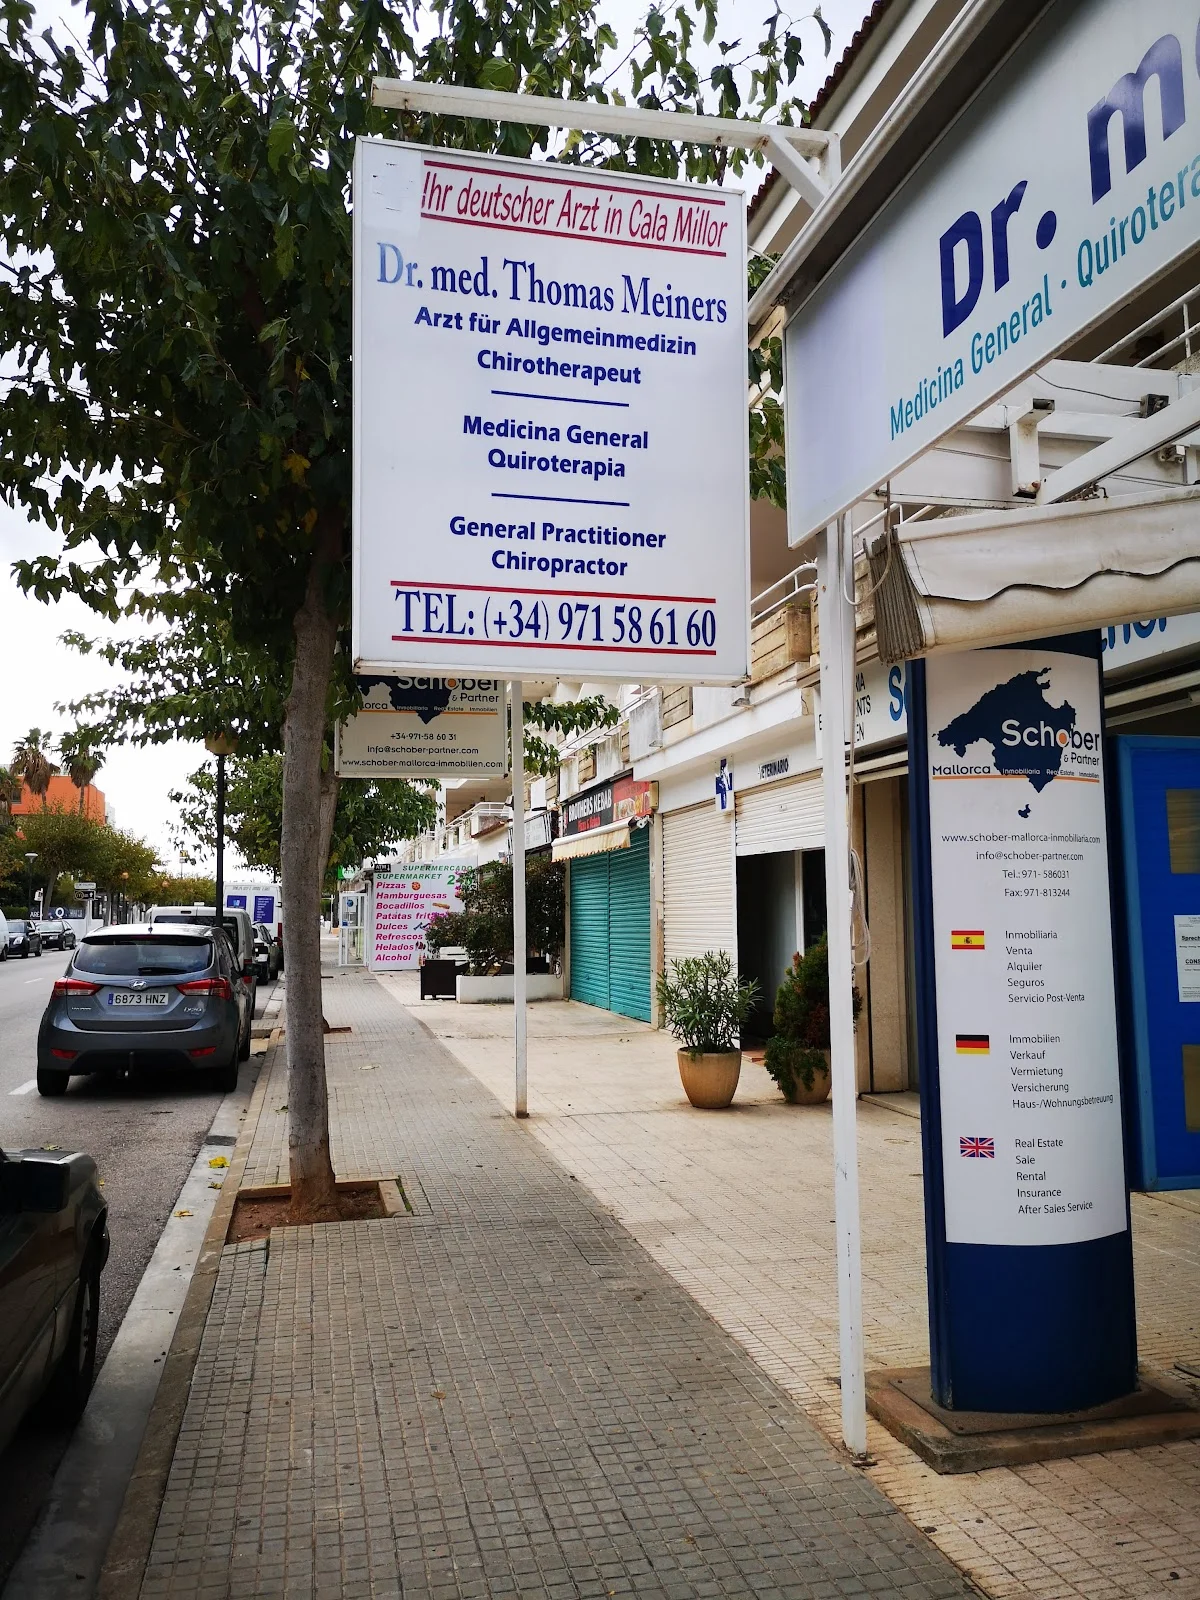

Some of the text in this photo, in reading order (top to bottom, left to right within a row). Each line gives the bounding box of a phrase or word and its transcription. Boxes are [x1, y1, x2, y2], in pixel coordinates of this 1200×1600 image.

[939, 17, 1200, 339] Dr. m
[421, 171, 729, 248] Ihr deutscher Arzt in Cala Millor
[376, 242, 727, 323] Dr. med. Thomas Meiners
[414, 306, 697, 355] Arzt für Allgemeinmedizin
[889, 358, 964, 441] Medicina
[970, 275, 1053, 375] General
[477, 349, 642, 386] Chirotherapeut
[463, 415, 649, 450] Medicina General
[488, 448, 626, 481] Quiroterapia
[449, 516, 667, 549] General Practitioner
[491, 549, 628, 578] Chiropractor
[395, 588, 716, 647] TEL: (+34) 971 58 61 60
[459, 692, 499, 703] Partner
[436, 733, 447, 741] 60
[1001, 718, 1100, 752] Schober
[342, 759, 503, 769] www.schober-mallorca-immobilien.com
[1070, 752, 1100, 767] Partner
[932, 763, 991, 776] Mallorca
[594, 788, 612, 814] KEBAB
[941, 832, 1101, 844] www.schober-mallorca-inmobiliaria.com
[976, 850, 1084, 862] info@schober-partner.com
[376, 873, 443, 881] SUPERMARKET
[1043, 869, 1070, 879] 586031
[376, 881, 407, 890] Pizzas
[376, 891, 448, 901] Hamburguesas
[375, 902, 425, 910] Bocadillos
[375, 912, 412, 920] Patatas
[375, 922, 408, 931] Dulces
[375, 933, 423, 941] Refrescos
[1005, 930, 1058, 940] Inmobiliaria
[375, 943, 414, 951] Helados
[1006, 946, 1033, 956] Venta
[375, 953, 411, 962] Alcohol
[1007, 962, 1043, 973] Alquiler
[1007, 977, 1045, 989] Seguros
[115, 994, 166, 1004] 6873 HNZ
[1008, 993, 1085, 1003] Servicio Post-Venta
[1009, 1034, 1061, 1044] Immobilien
[1010, 1050, 1046, 1060] Verkauf
[1011, 1066, 1064, 1078] Vermietung
[1011, 1082, 1069, 1094] Versicherung
[1012, 1093, 1114, 1110] Haus-/Wohnungsbetreuung
[1015, 1138, 1064, 1148] Real Estate
[1015, 1155, 1036, 1165] Sale
[1016, 1171, 1047, 1181] Rental
[1017, 1187, 1062, 1198] Insurance
[1018, 1200, 1094, 1214] After Sales Service
